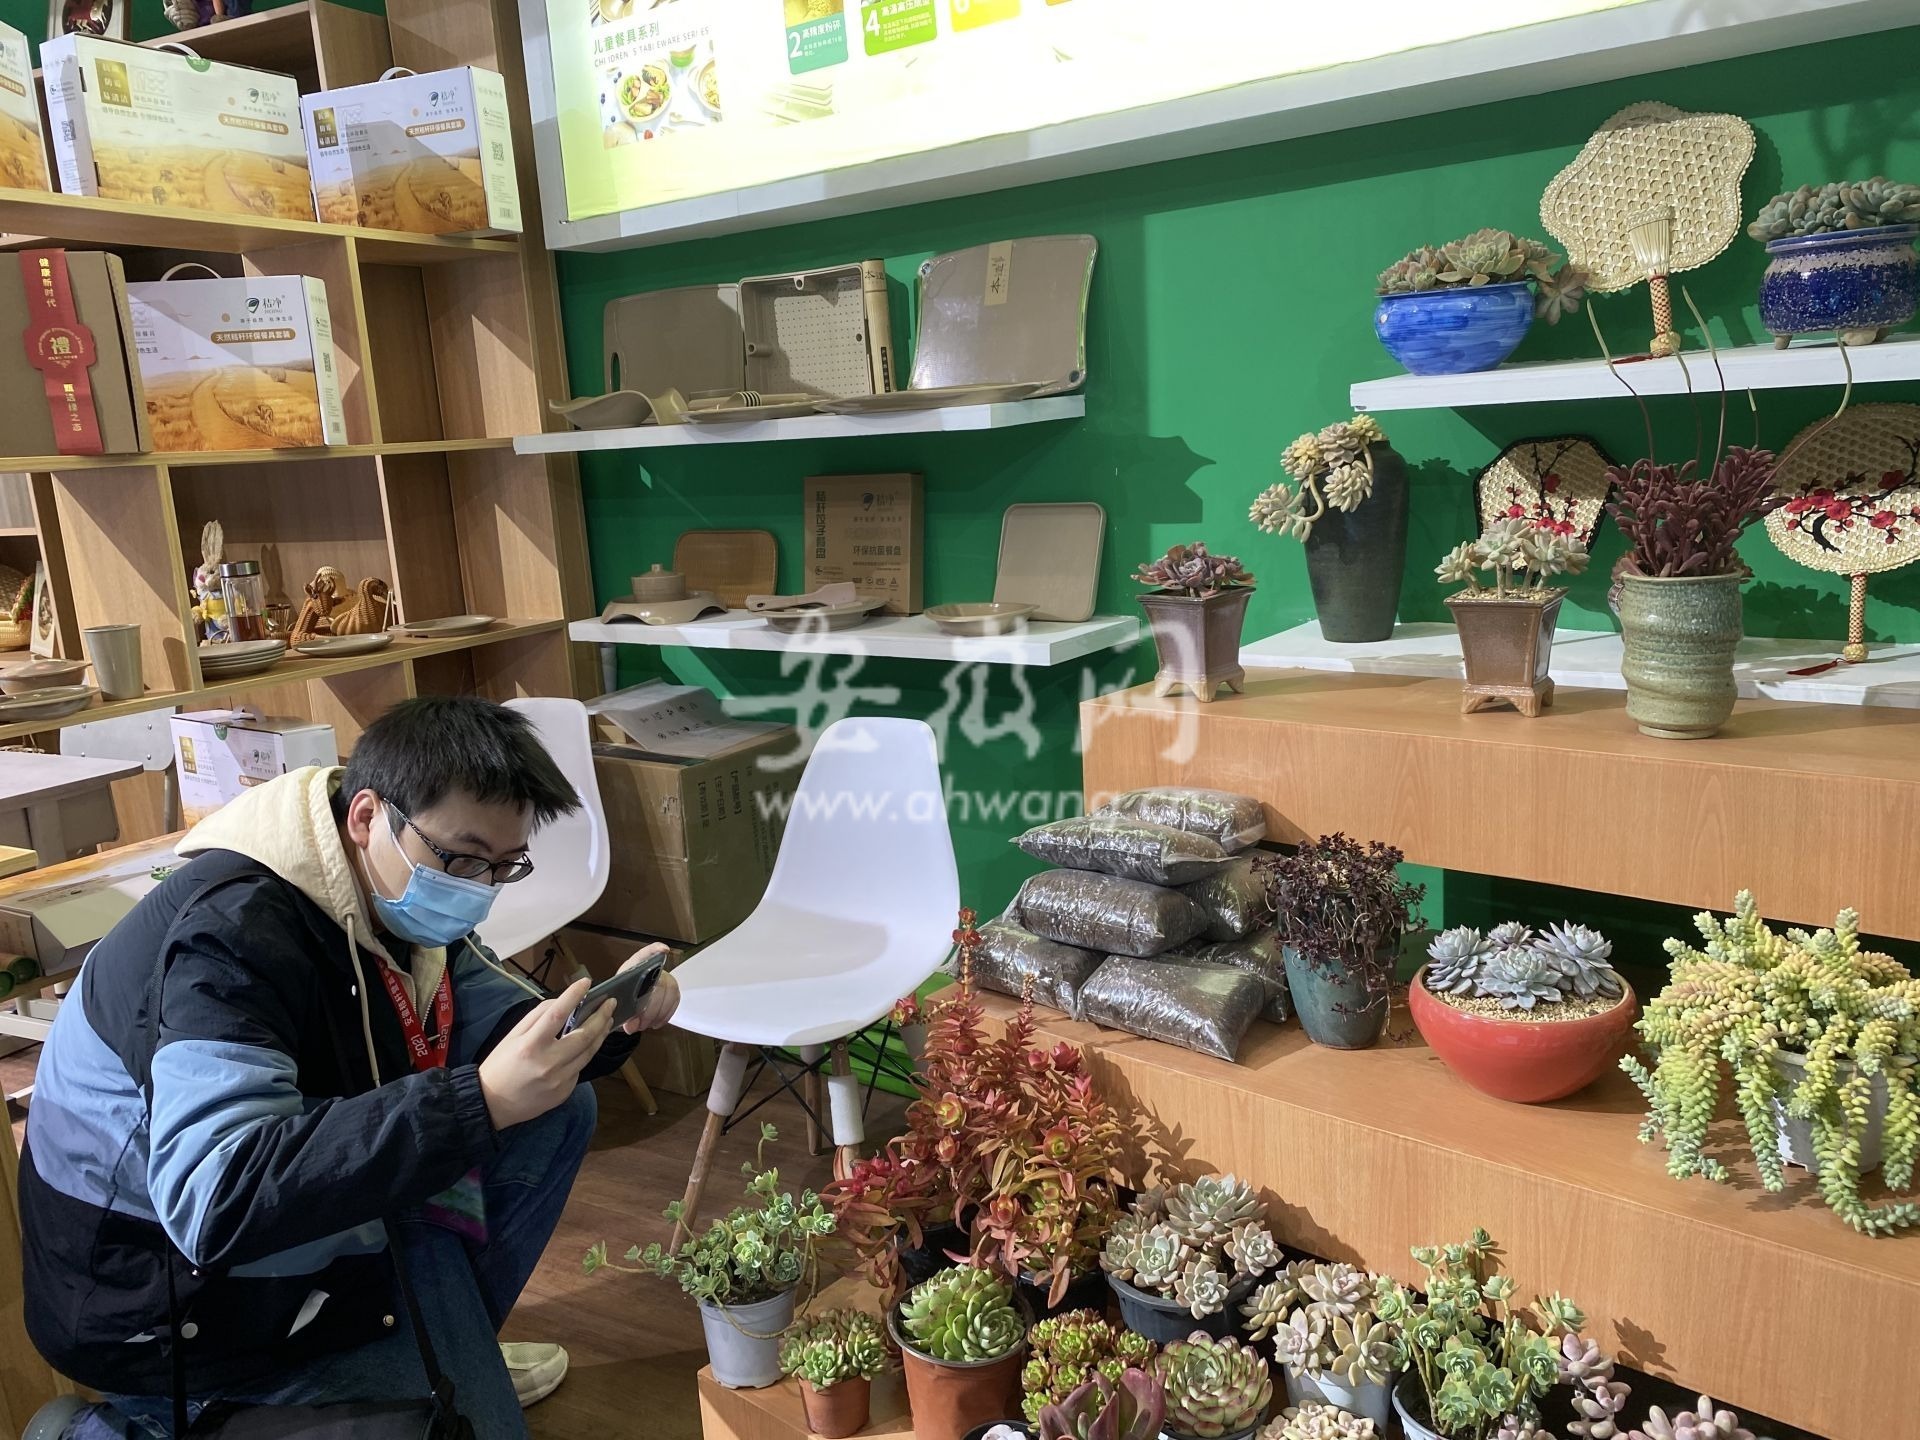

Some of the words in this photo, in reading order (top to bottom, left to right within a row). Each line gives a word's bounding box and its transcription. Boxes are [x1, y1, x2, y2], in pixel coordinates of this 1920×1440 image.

[593, 19, 660, 55] 儿童餐具系列
[802, 19, 842, 39] 高精度粉碎
[865, 9, 881, 37] 4
[594, 47, 637, 68] CHILDRENS
[682, 26, 709, 41] SERIES
[788, 31, 803, 59] 2
[38, 257, 57, 308] 健康新时代
[50, 336, 73, 355] 禮
[215, 329, 291, 343] 天然秸秆环保餐具套装
[437, 981, 450, 1011] 安徽秸
[410, 1033, 428, 1057] 2021
[438, 1023, 450, 1050] 2021
